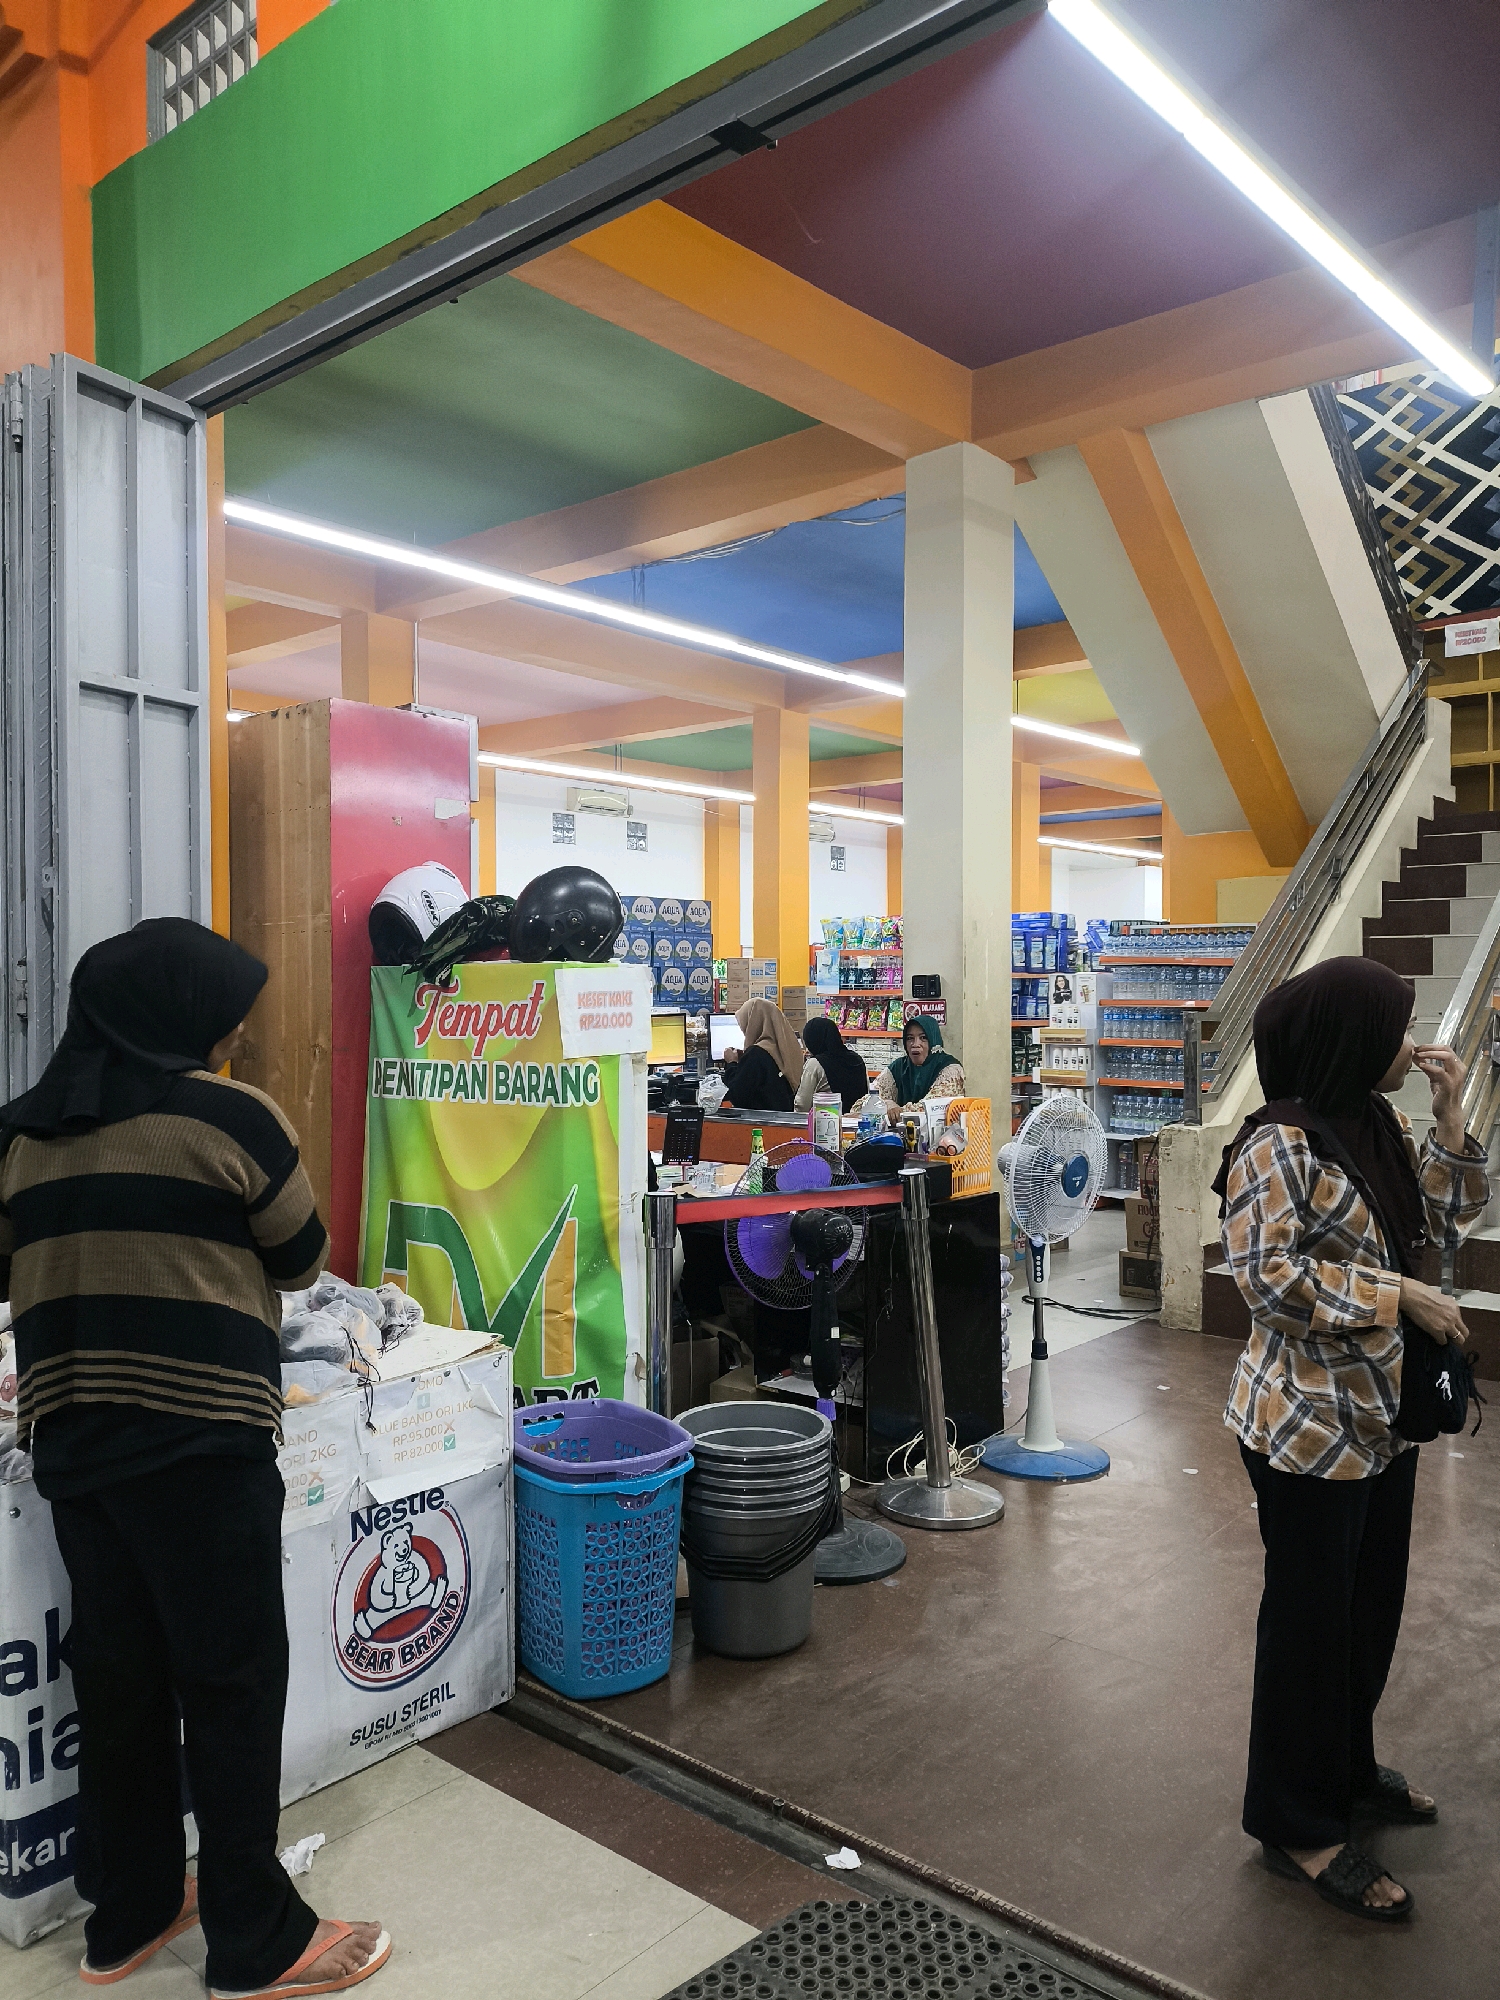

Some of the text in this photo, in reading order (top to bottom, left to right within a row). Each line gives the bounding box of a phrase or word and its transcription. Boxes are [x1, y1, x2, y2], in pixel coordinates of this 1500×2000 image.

[423, 894, 439, 922] INK
[634, 904, 654, 914] AQUA
[661, 904, 681, 916] AQUA
[689, 907, 707, 918] AQUA
[664, 975, 683, 986] AQUA
[691, 975, 709, 986] AQUA
[577, 990, 633, 1009] KESET KAKI
[415, 977, 546, 1058] Tempat
[373, 1059, 599, 1106] PENITIPAN BARANG
[401, 1410, 433, 1428] BAND
[436, 1405, 454, 1418] ORI
[393, 1424, 444, 1447] RP.95.000
[282, 1443, 337, 1471] ORI 2KG
[393, 1440, 444, 1463] RP.82.000
[344, 1591, 460, 1672] BEAR BRAND
[349, 1710, 397, 1747] SUSU
[400, 1681, 456, 1723] STERIL
